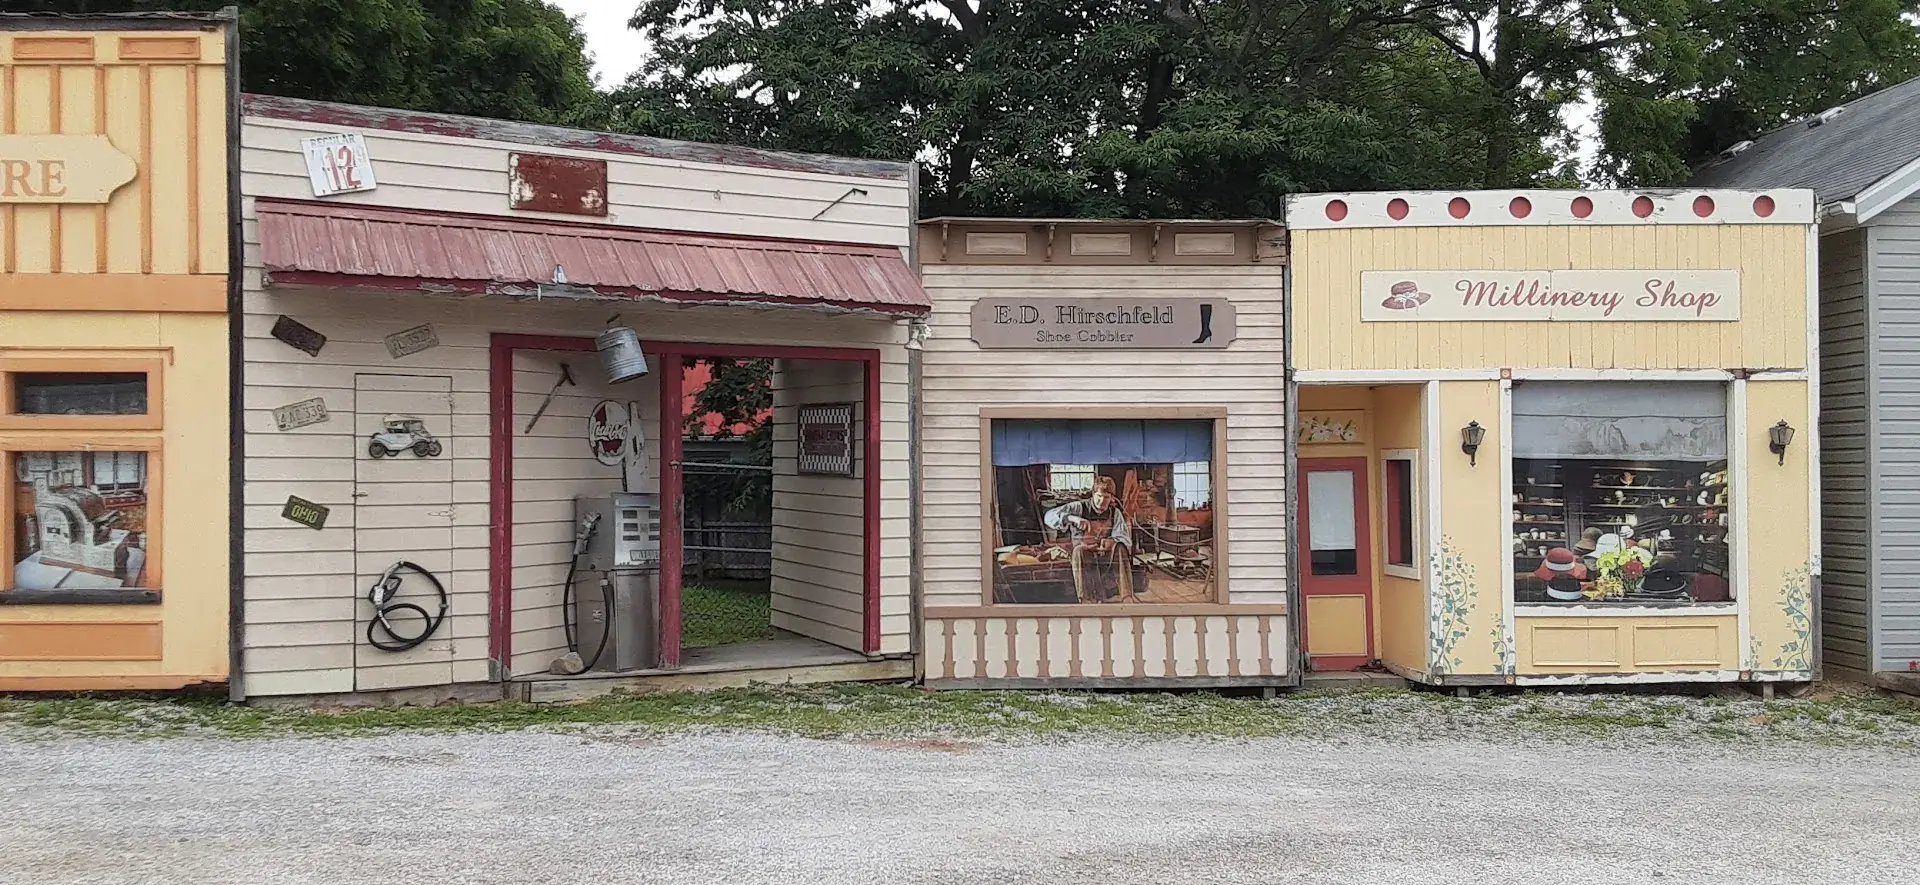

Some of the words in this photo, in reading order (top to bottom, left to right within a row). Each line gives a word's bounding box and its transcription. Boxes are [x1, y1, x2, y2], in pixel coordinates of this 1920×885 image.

[1454, 278, 1625, 317] Millinery
[1635, 278, 1722, 318] Shop
[993, 304, 1046, 325] E.D.
[1055, 304, 1174, 325] Hirschfeld
[1035, 329, 1071, 343] Shoe
[1076, 329, 1135, 343] Cobbler
[290, 504, 319, 524] OHIO
